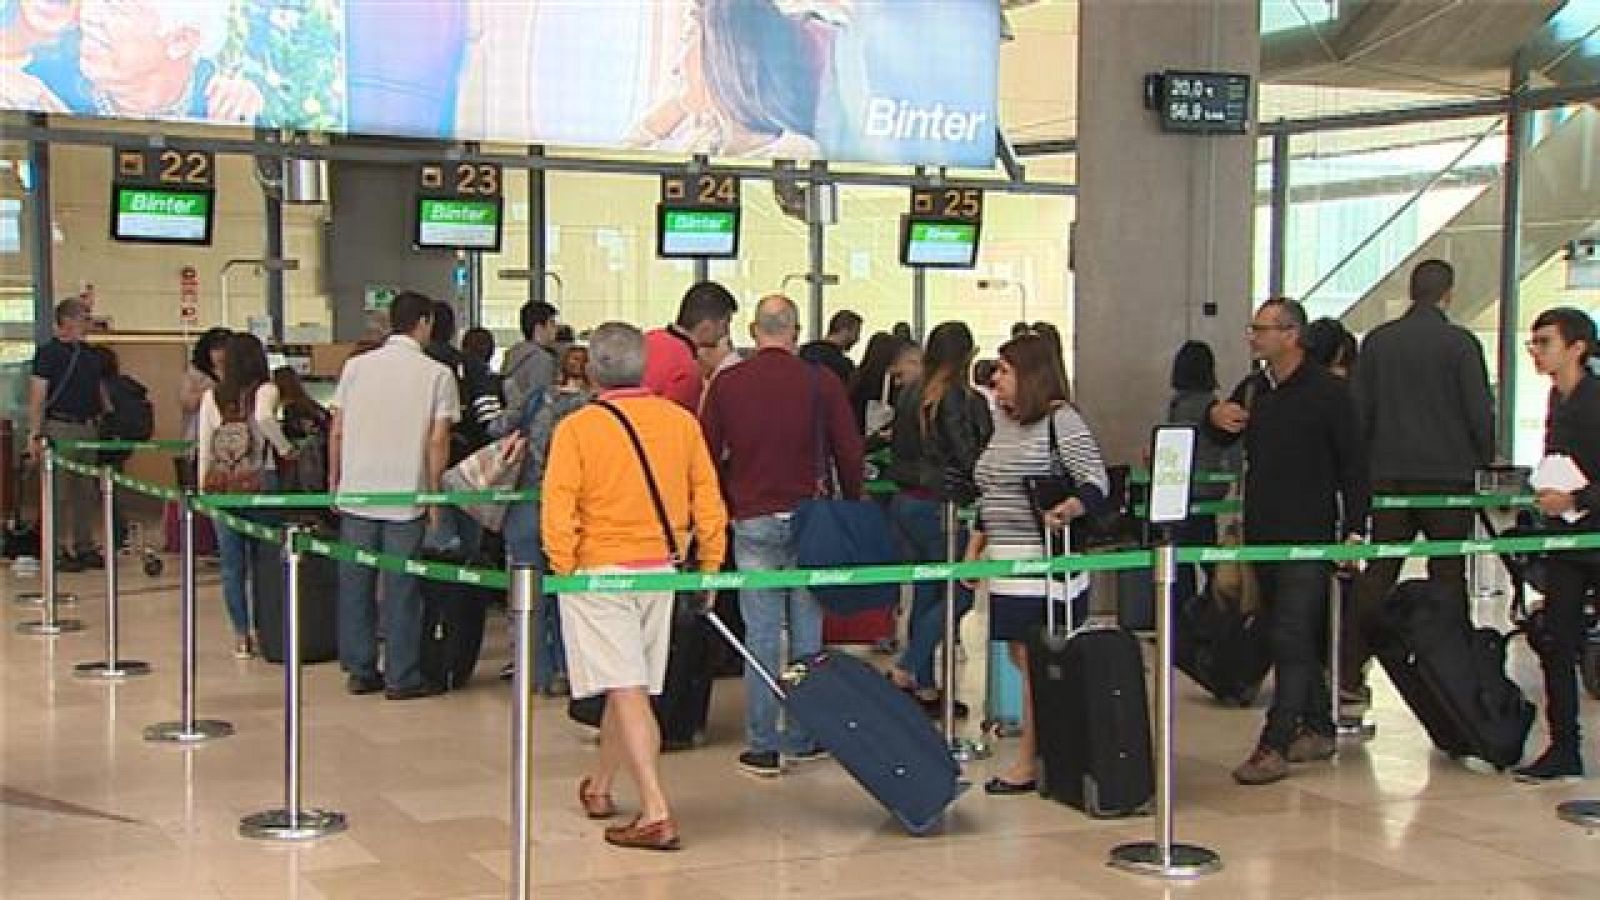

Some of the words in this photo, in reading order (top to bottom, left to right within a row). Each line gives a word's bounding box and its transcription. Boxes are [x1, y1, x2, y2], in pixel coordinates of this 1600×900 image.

[865, 97, 986, 141] Binter
[160, 151, 208, 183] 22
[457, 164, 498, 195] 23
[131, 192, 196, 214] Binter
[697, 174, 736, 204] 24
[944, 189, 979, 217] 25
